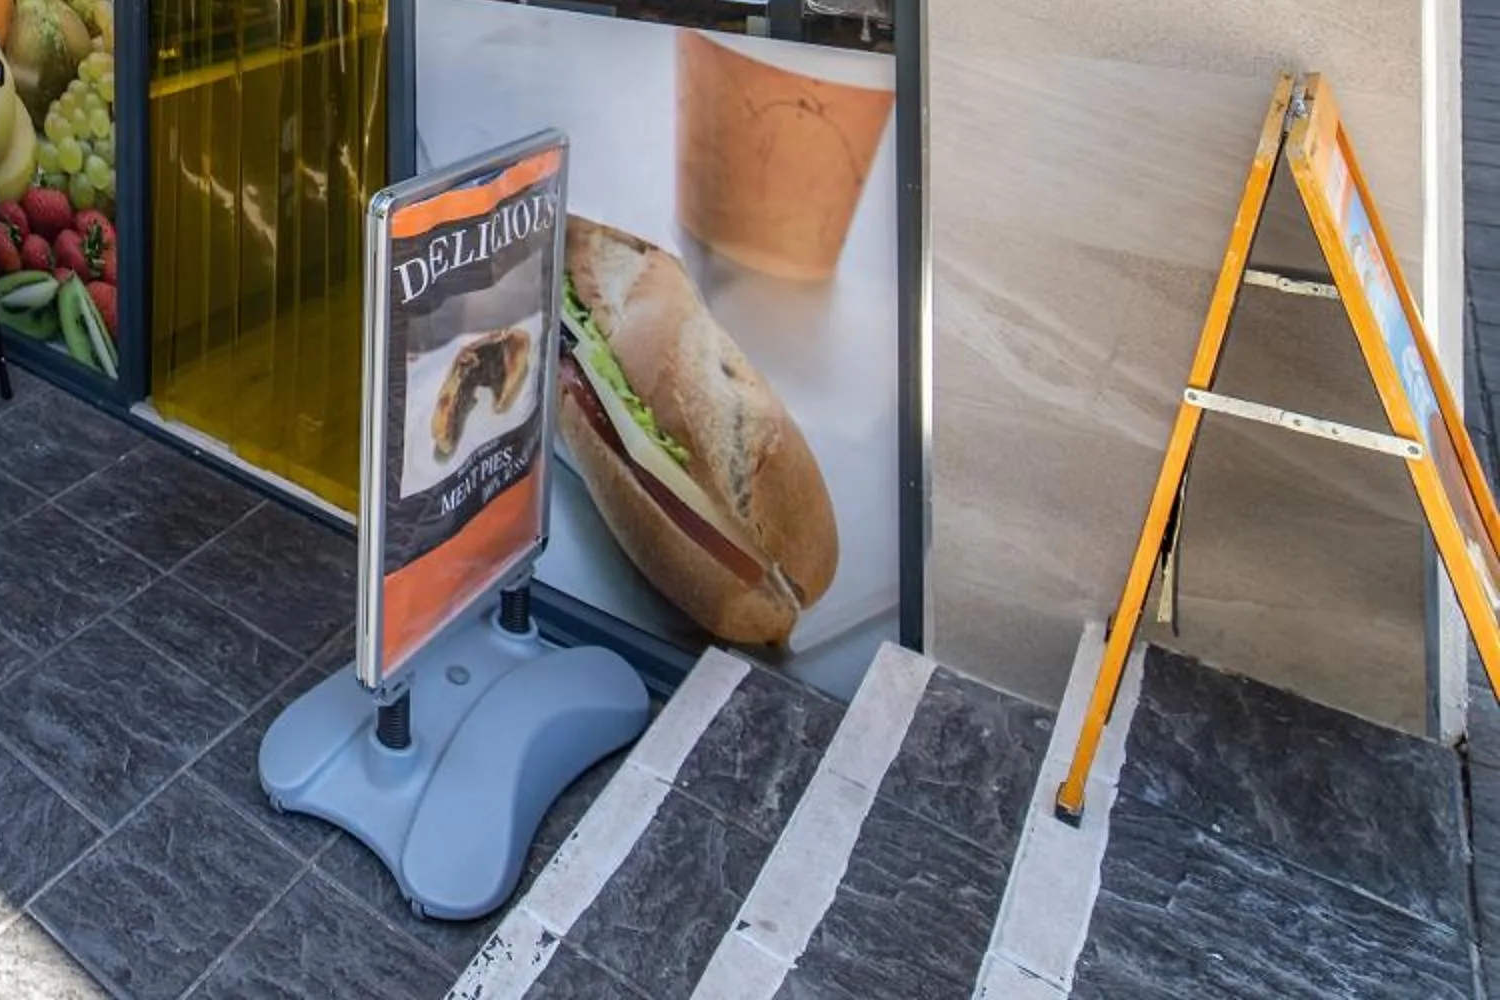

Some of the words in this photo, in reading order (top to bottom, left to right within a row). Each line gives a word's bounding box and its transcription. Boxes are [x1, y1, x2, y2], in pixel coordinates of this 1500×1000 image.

[393, 193, 558, 305] DELICIOUS
[441, 464, 479, 517] MEAT
[480, 445, 514, 481] PIES
